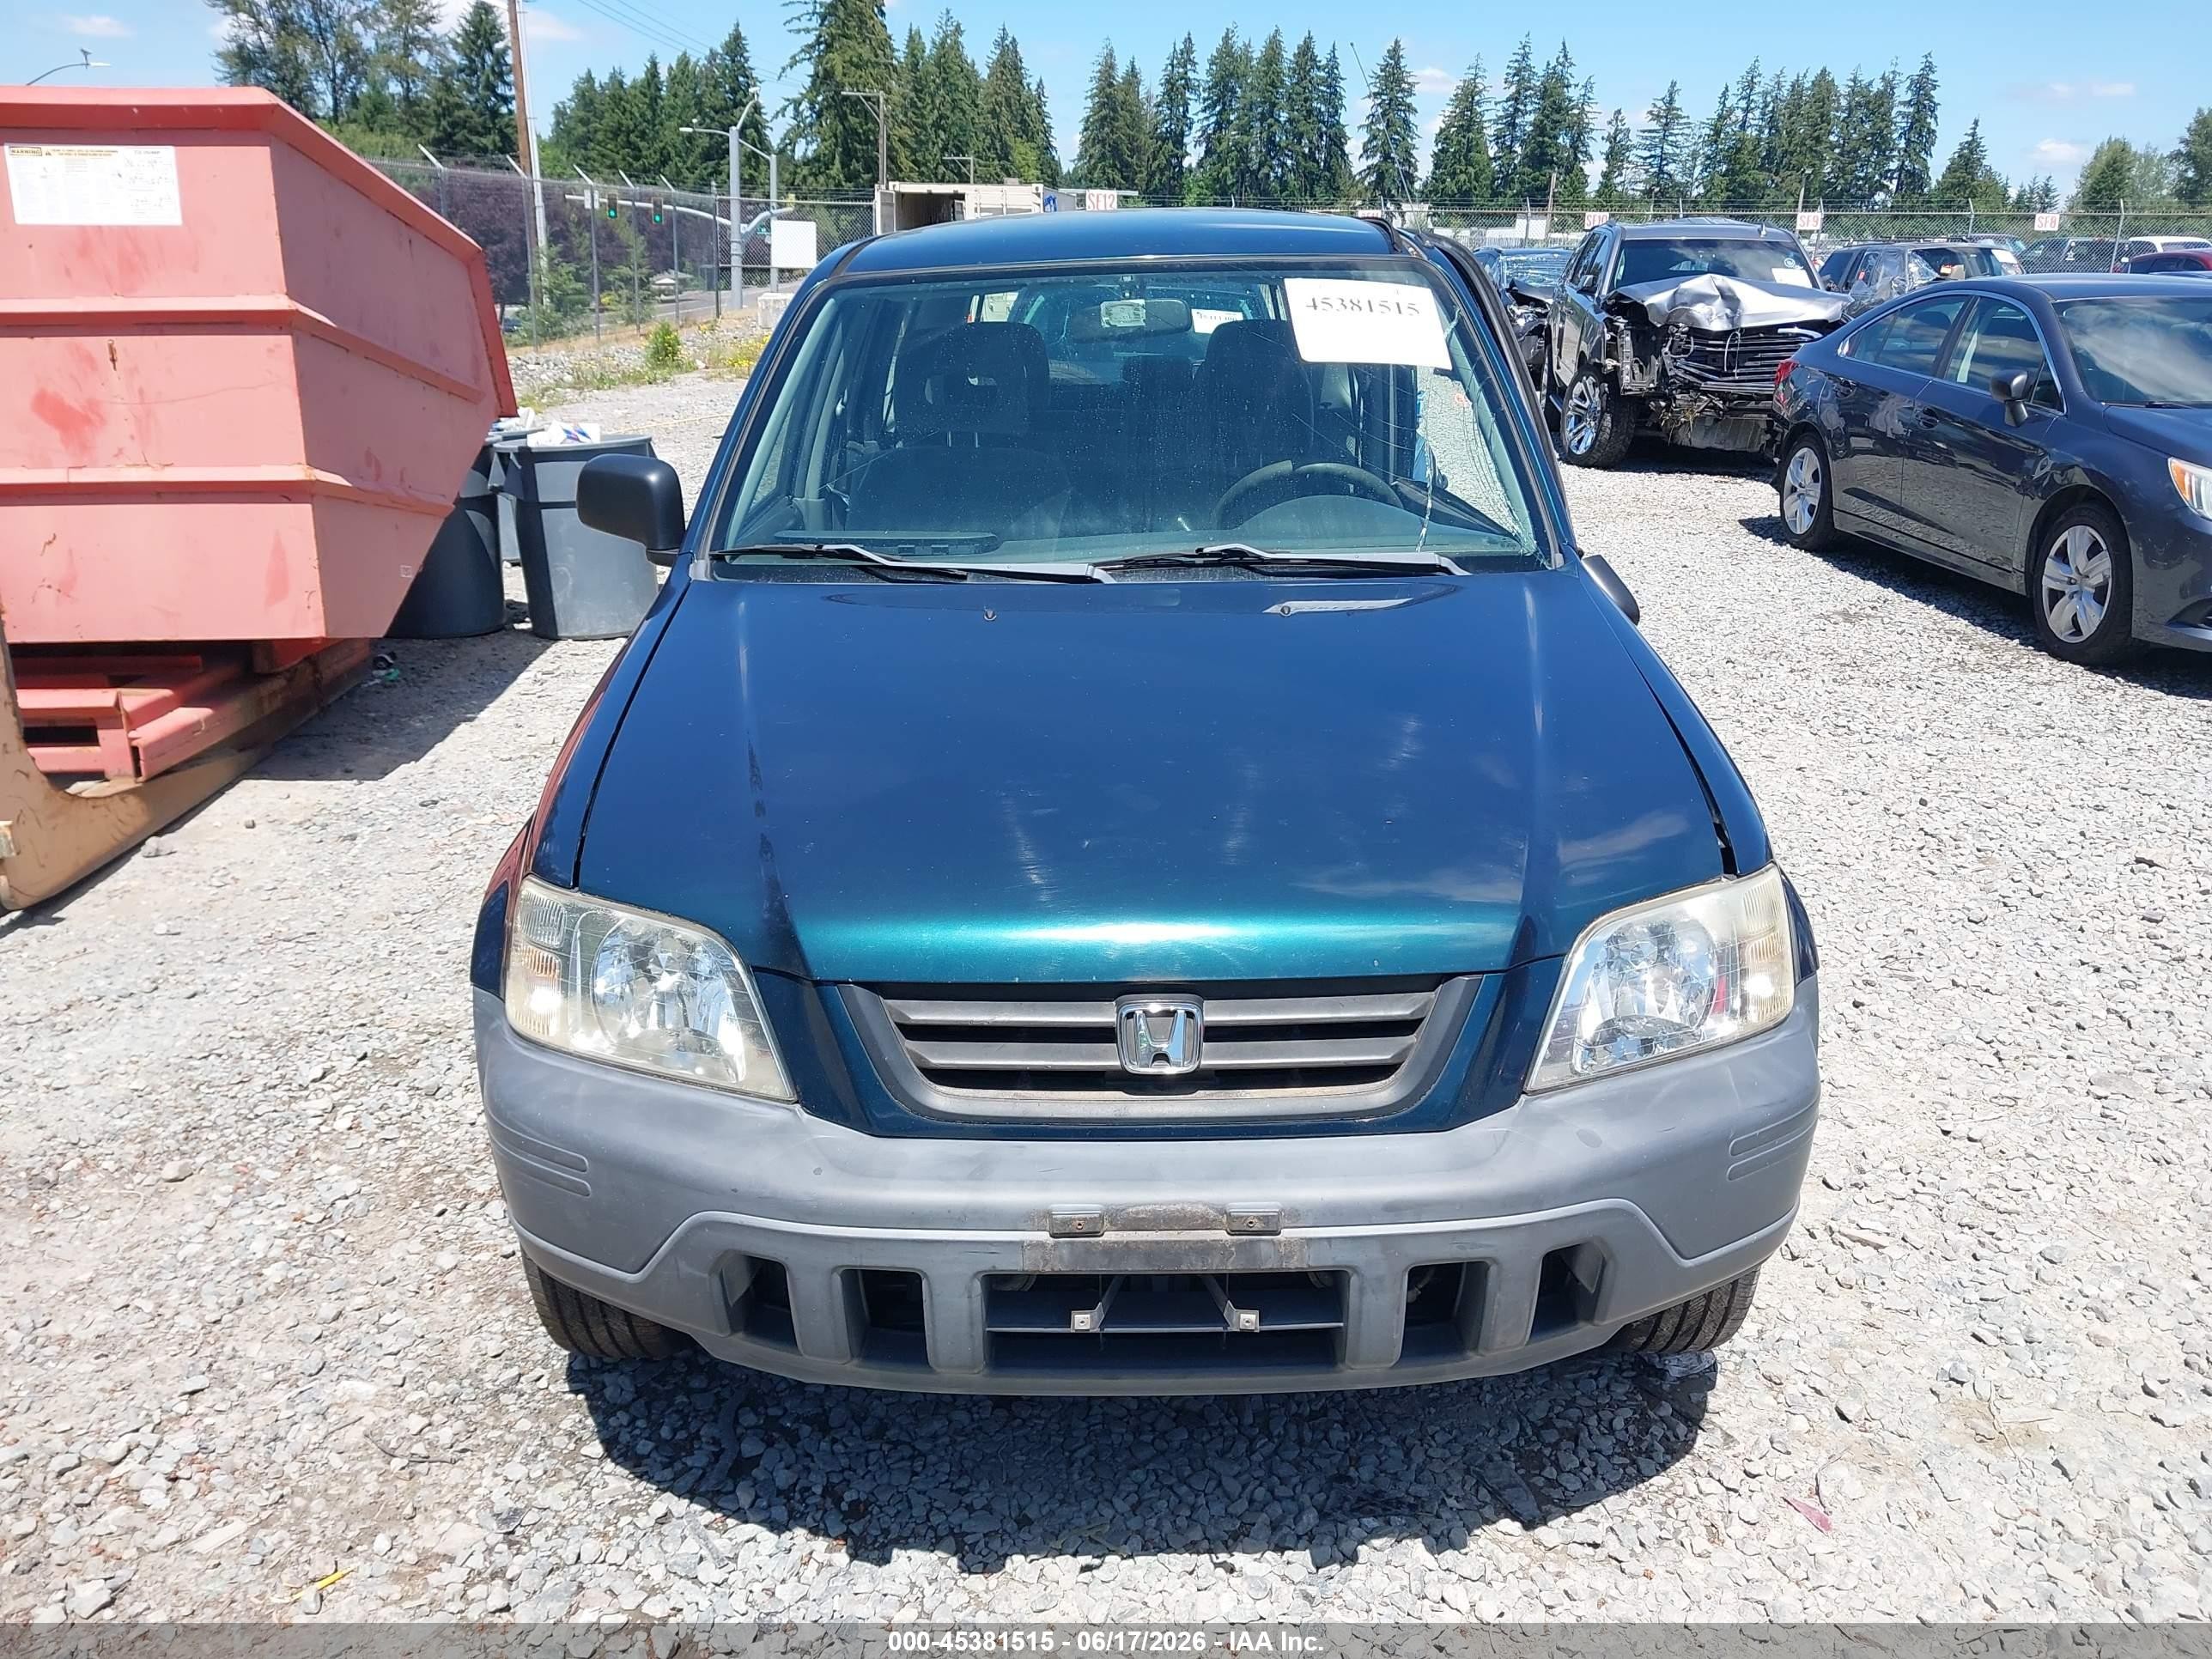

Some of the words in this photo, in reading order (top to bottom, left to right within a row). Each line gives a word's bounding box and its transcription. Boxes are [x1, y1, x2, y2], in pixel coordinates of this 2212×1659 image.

[1088, 192, 1115, 210] SF12
[1799, 215, 1820, 228] SF9
[2037, 216, 2057, 228] SF8
[1305, 297, 1420, 316] 45381515
